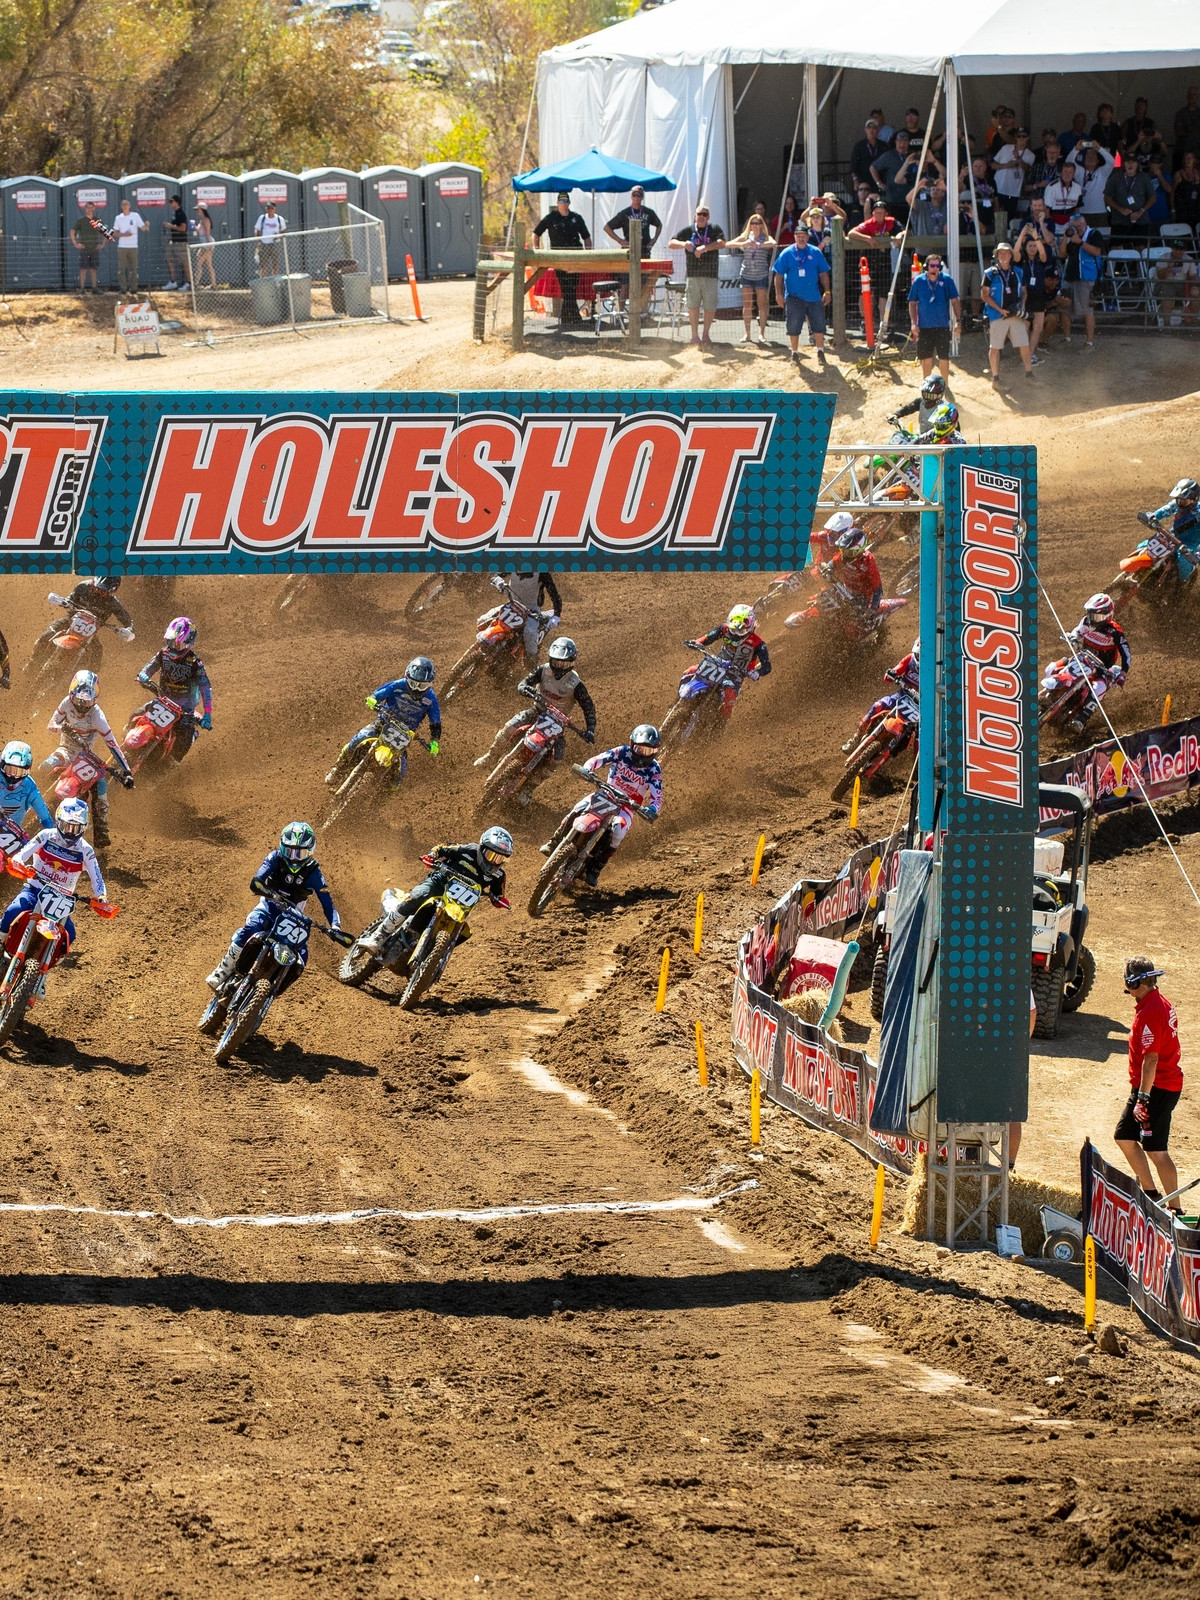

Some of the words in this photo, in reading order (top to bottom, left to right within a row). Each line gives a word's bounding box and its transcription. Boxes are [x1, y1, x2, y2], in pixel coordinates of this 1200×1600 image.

[126, 411, 774, 553] HOLESHOT
[979, 472, 1019, 489] .com
[49, 455, 79, 547] .com
[499, 608, 524, 629] 112
[145, 702, 175, 728] 39
[536, 715, 563, 737] 73
[72, 760, 98, 782] 18
[41, 893, 73, 918] 115
[448, 883, 479, 907] 90
[277, 918, 308, 945] 59
